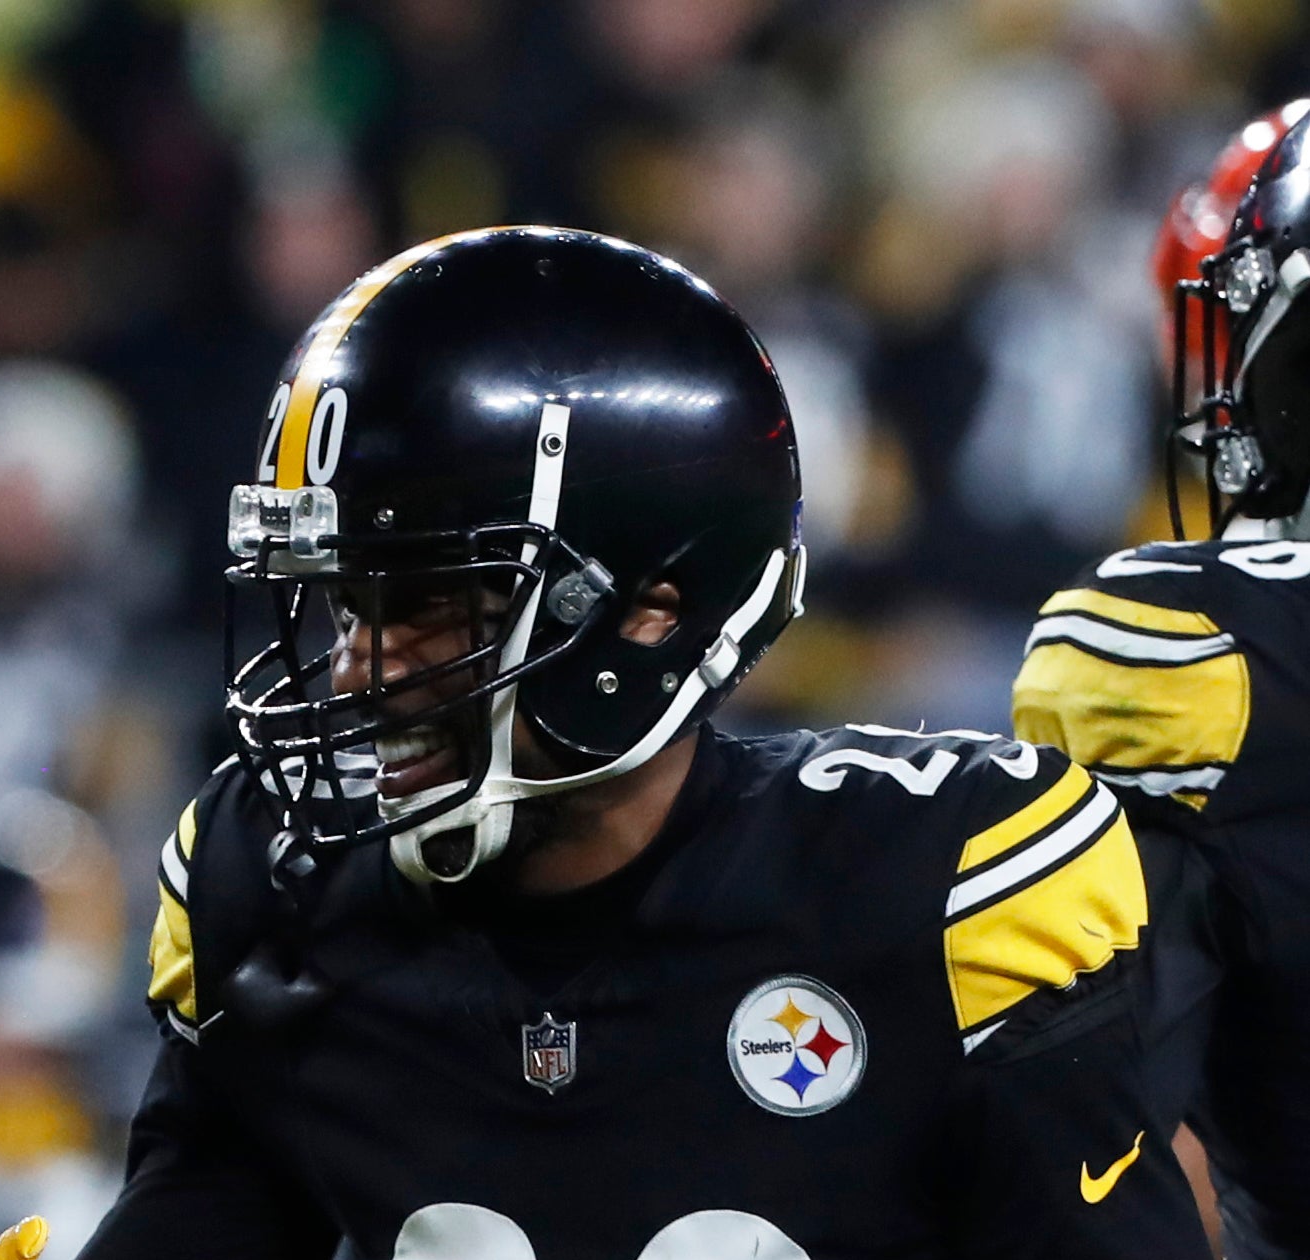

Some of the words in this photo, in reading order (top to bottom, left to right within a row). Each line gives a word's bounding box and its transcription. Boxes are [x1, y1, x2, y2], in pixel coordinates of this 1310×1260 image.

[258, 383, 348, 485] 20
[740, 1038, 793, 1056] Steelers
[529, 1048, 568, 1079] NFL
